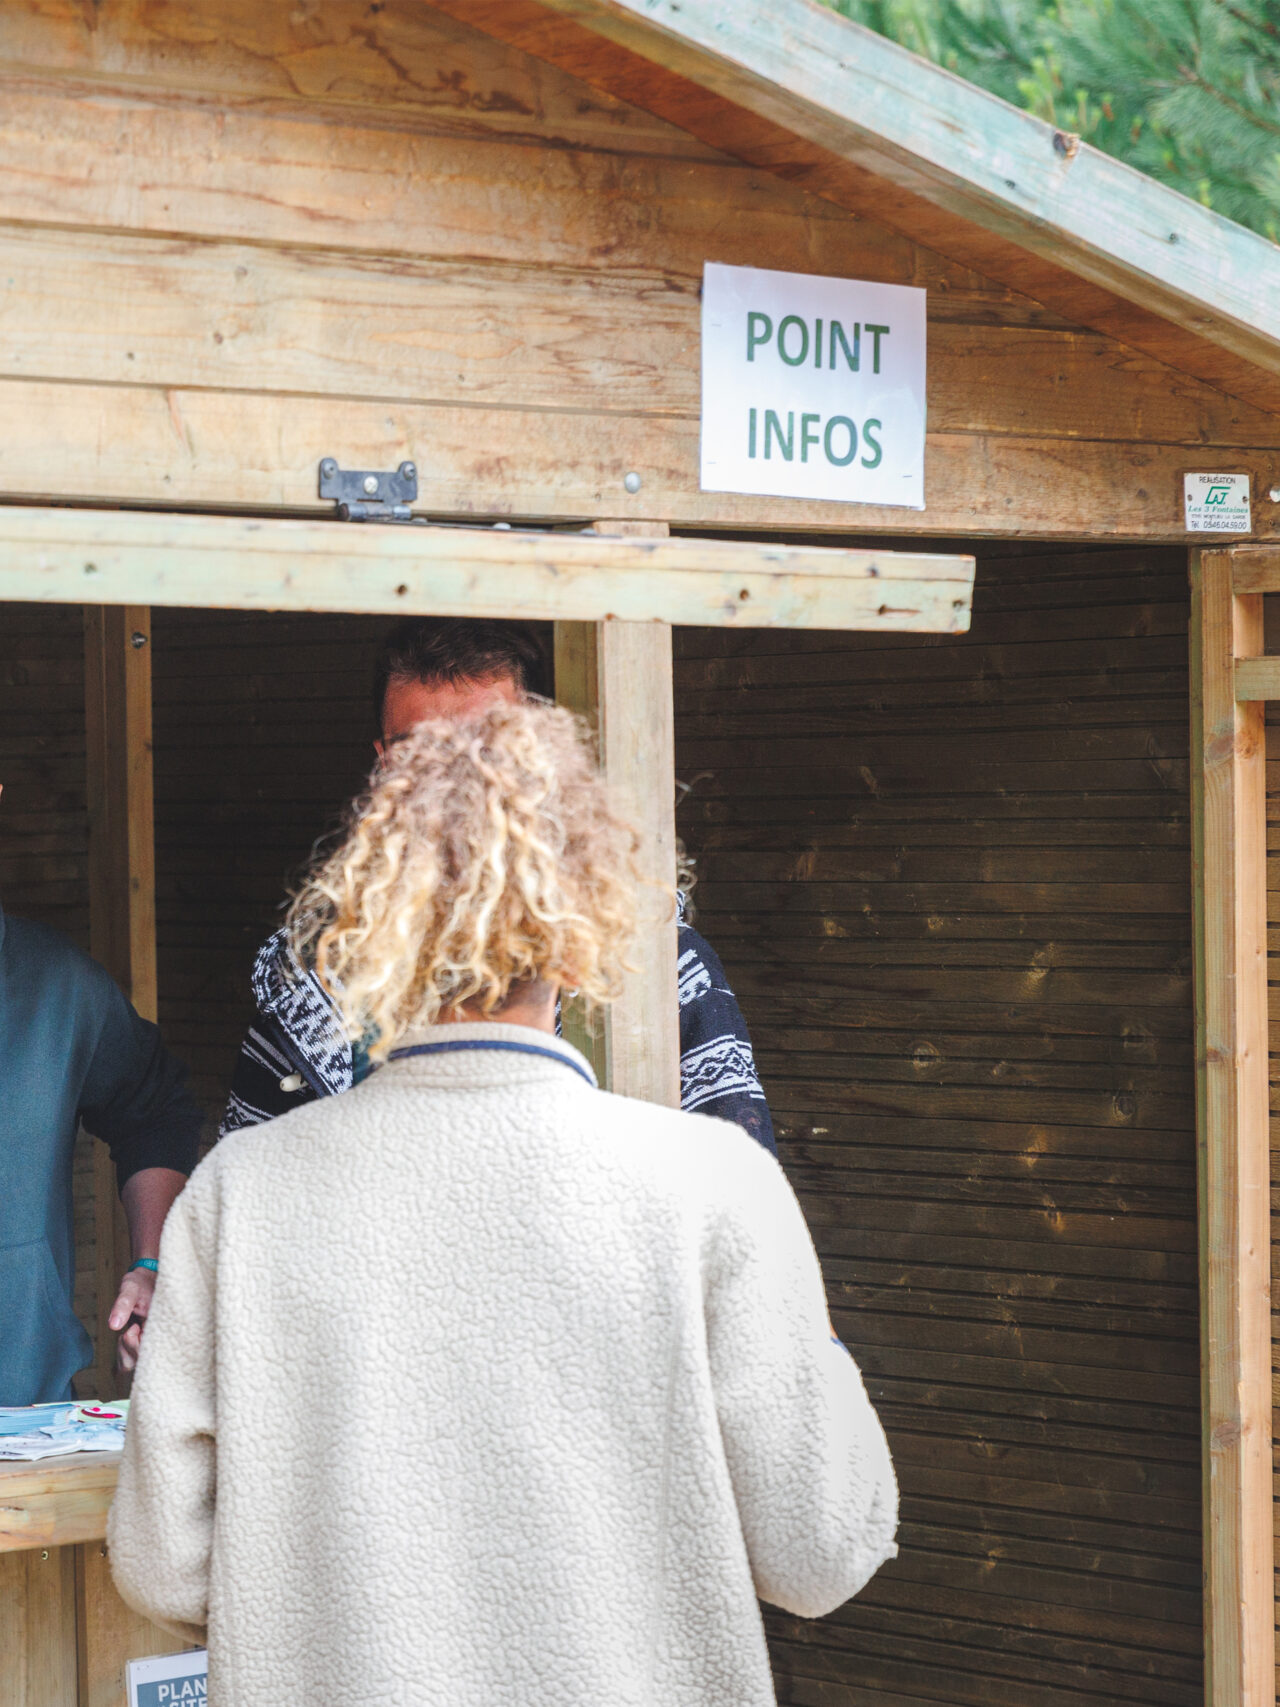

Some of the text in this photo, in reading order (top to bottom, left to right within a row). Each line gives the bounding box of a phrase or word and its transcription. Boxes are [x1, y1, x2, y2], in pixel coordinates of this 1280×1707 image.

[746, 311, 891, 375] POINT
[747, 407, 884, 470] INFOS
[1187, 505, 1202, 513] Les
[1212, 506, 1249, 514] Fontaines
[158, 1677, 208, 1703] PLAN
